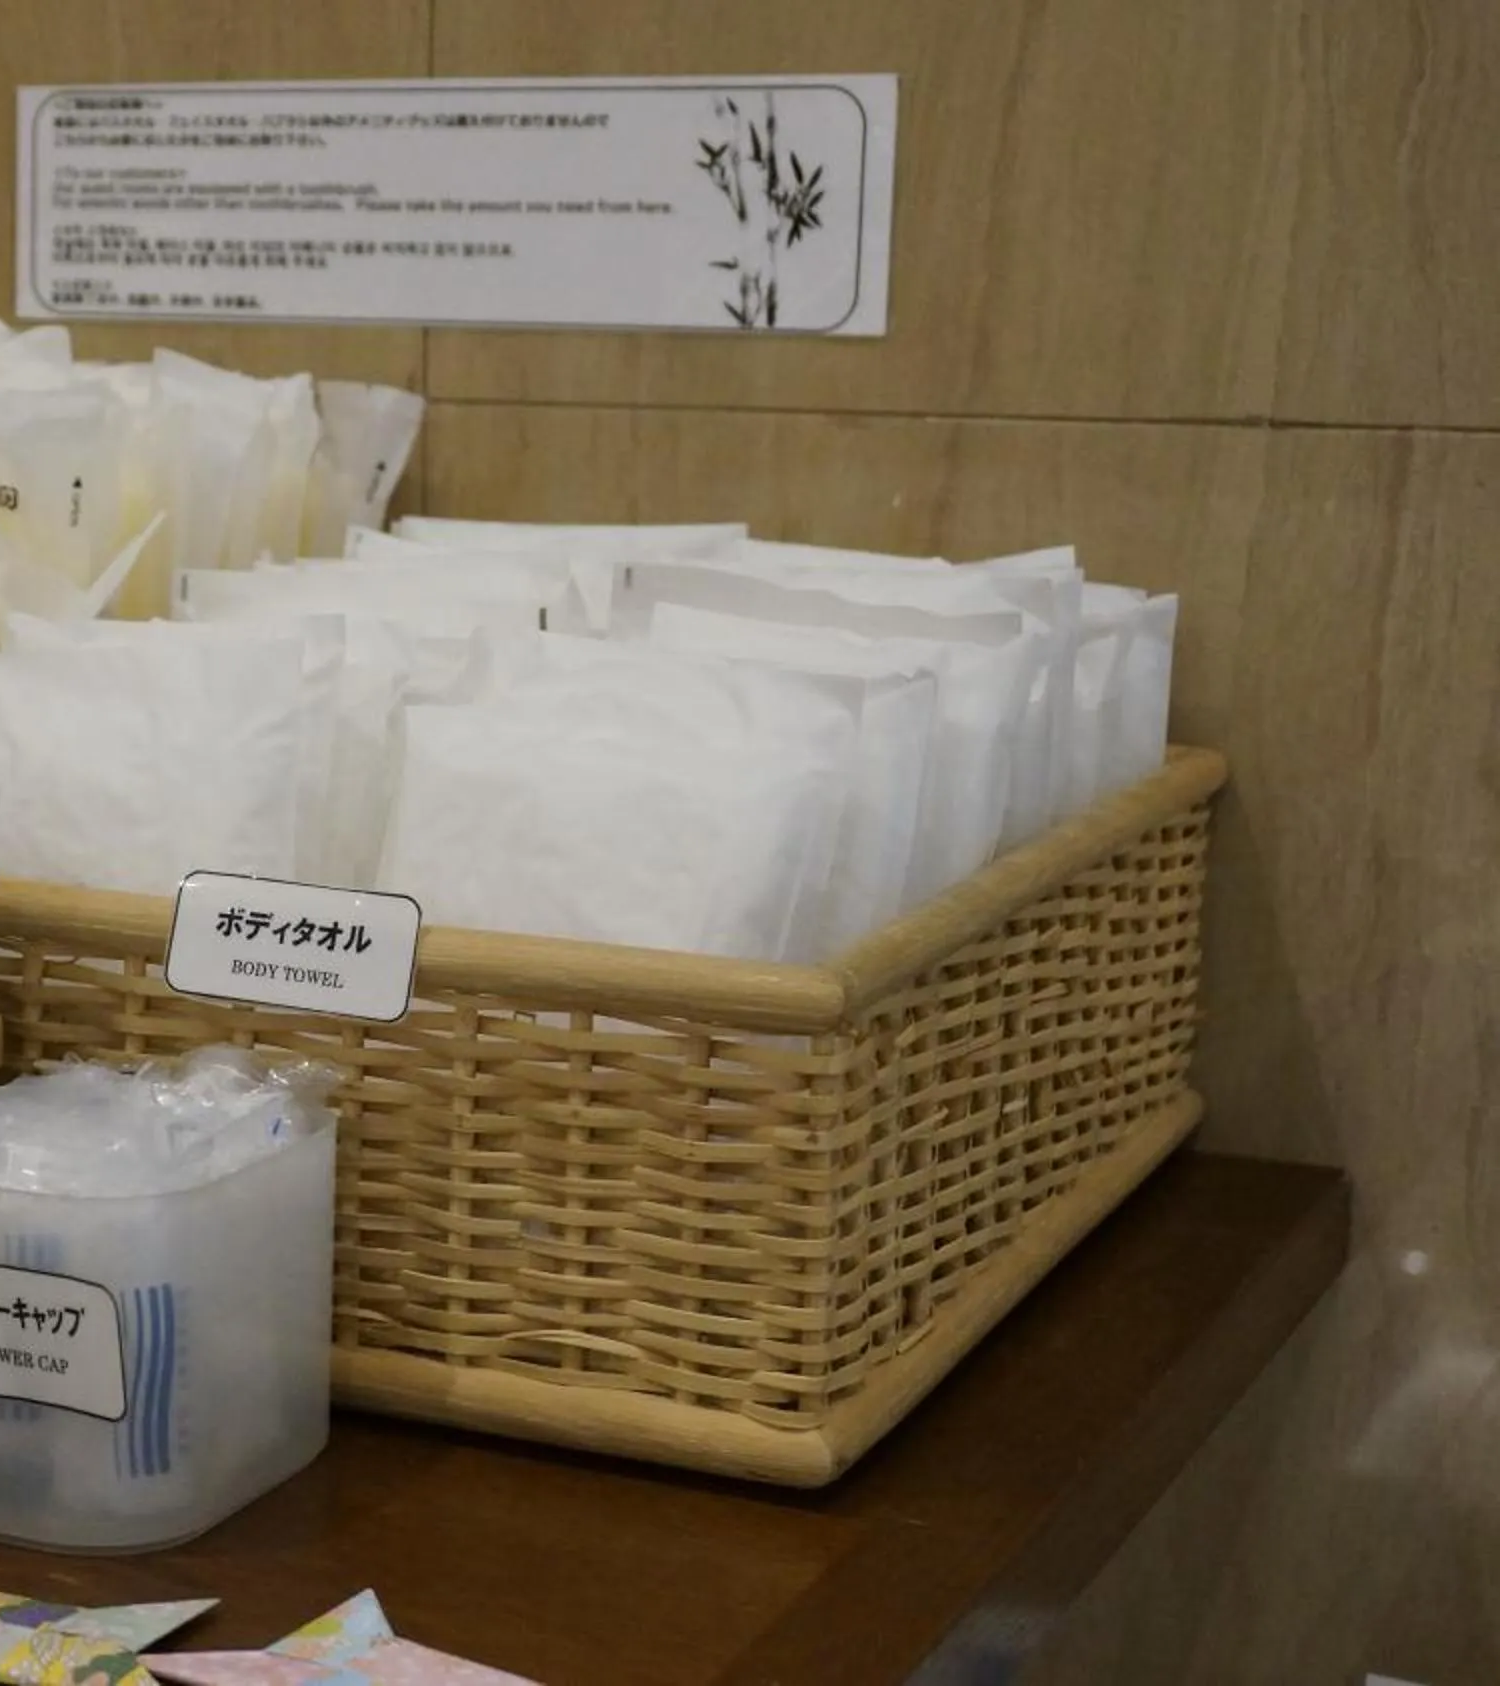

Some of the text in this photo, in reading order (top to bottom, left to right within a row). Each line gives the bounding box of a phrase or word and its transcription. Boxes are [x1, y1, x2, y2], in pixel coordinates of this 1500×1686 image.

[215, 907, 372, 953] ボディタオル
[231, 959, 345, 989] BODY TOWEL
[37, 1354, 69, 1375] CAP
